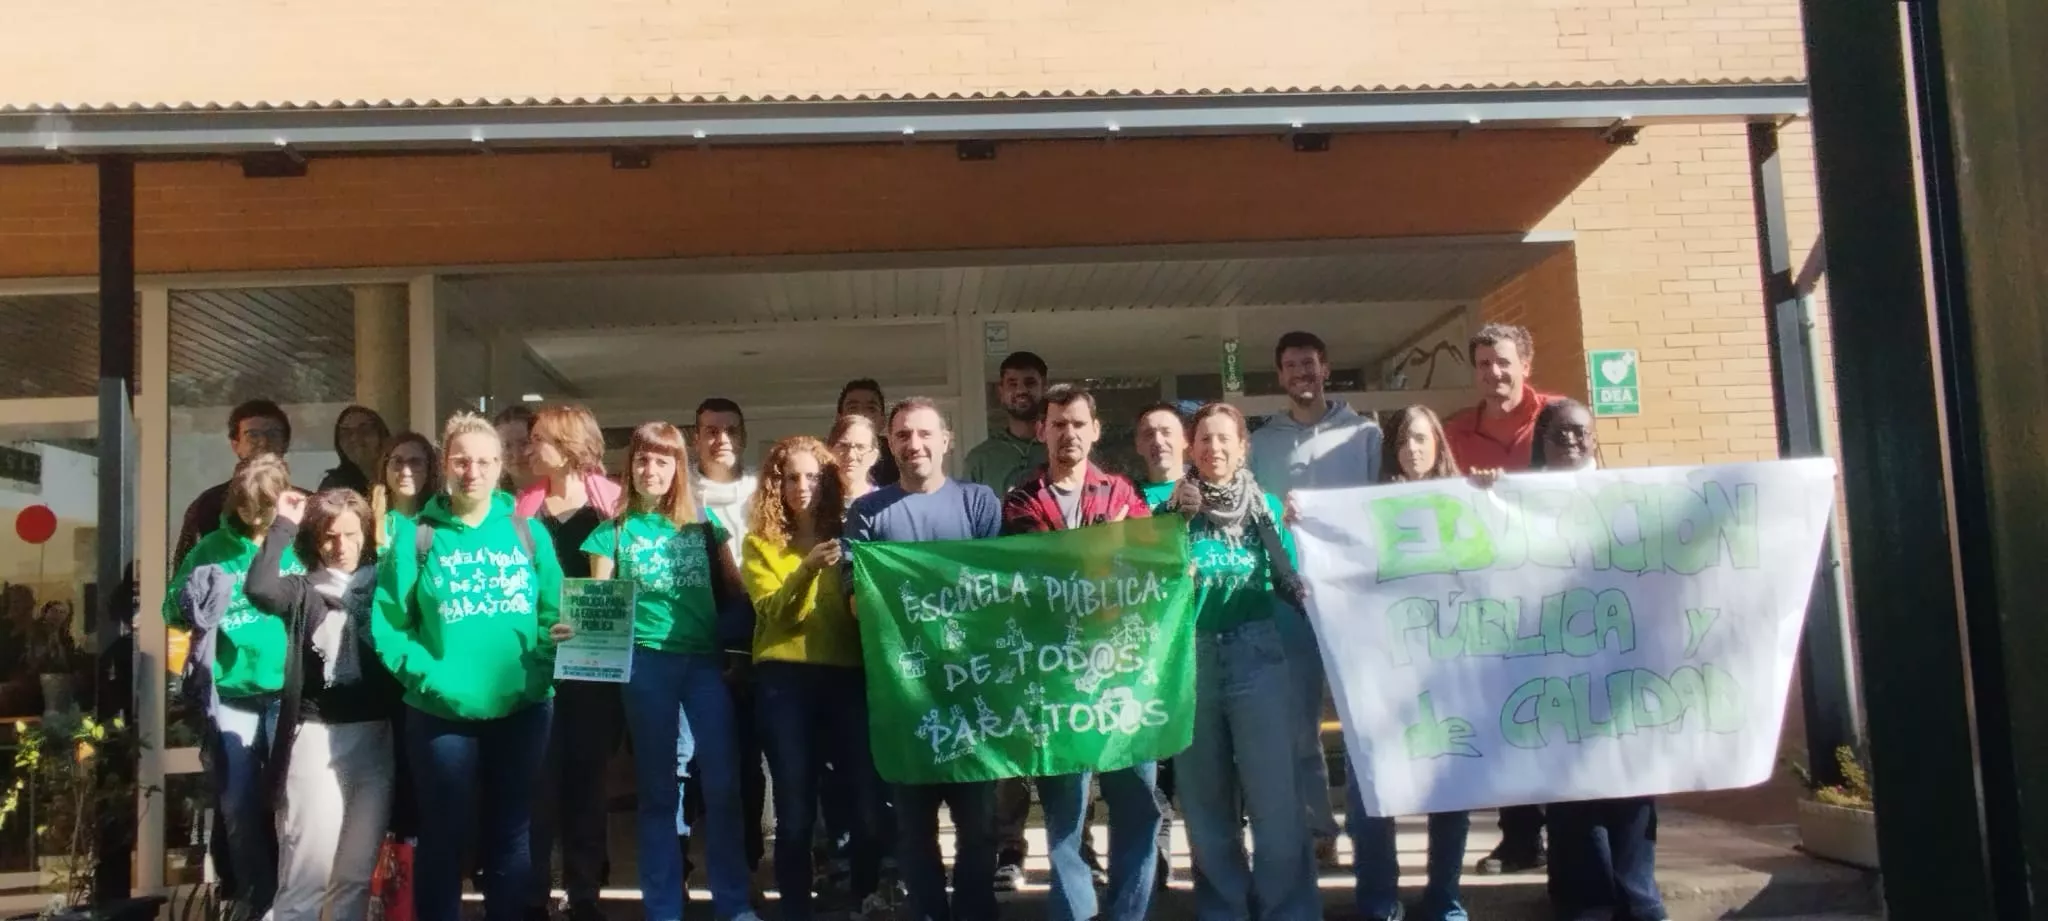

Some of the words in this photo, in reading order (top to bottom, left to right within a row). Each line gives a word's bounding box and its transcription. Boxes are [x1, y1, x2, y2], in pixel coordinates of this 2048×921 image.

[1601, 388, 1633, 403] DEA
[902, 572, 1032, 624] ESCUELA
[1044, 570, 1168, 618] PÚBLICA:
[1386, 587, 1637, 667] PÚBLICA
[945, 654, 993, 691] DE
[1011, 642, 1143, 679] TOD@S
[929, 706, 1031, 753] PARA
[1404, 690, 1483, 760] de
[1499, 662, 1746, 750] CALIDAD
